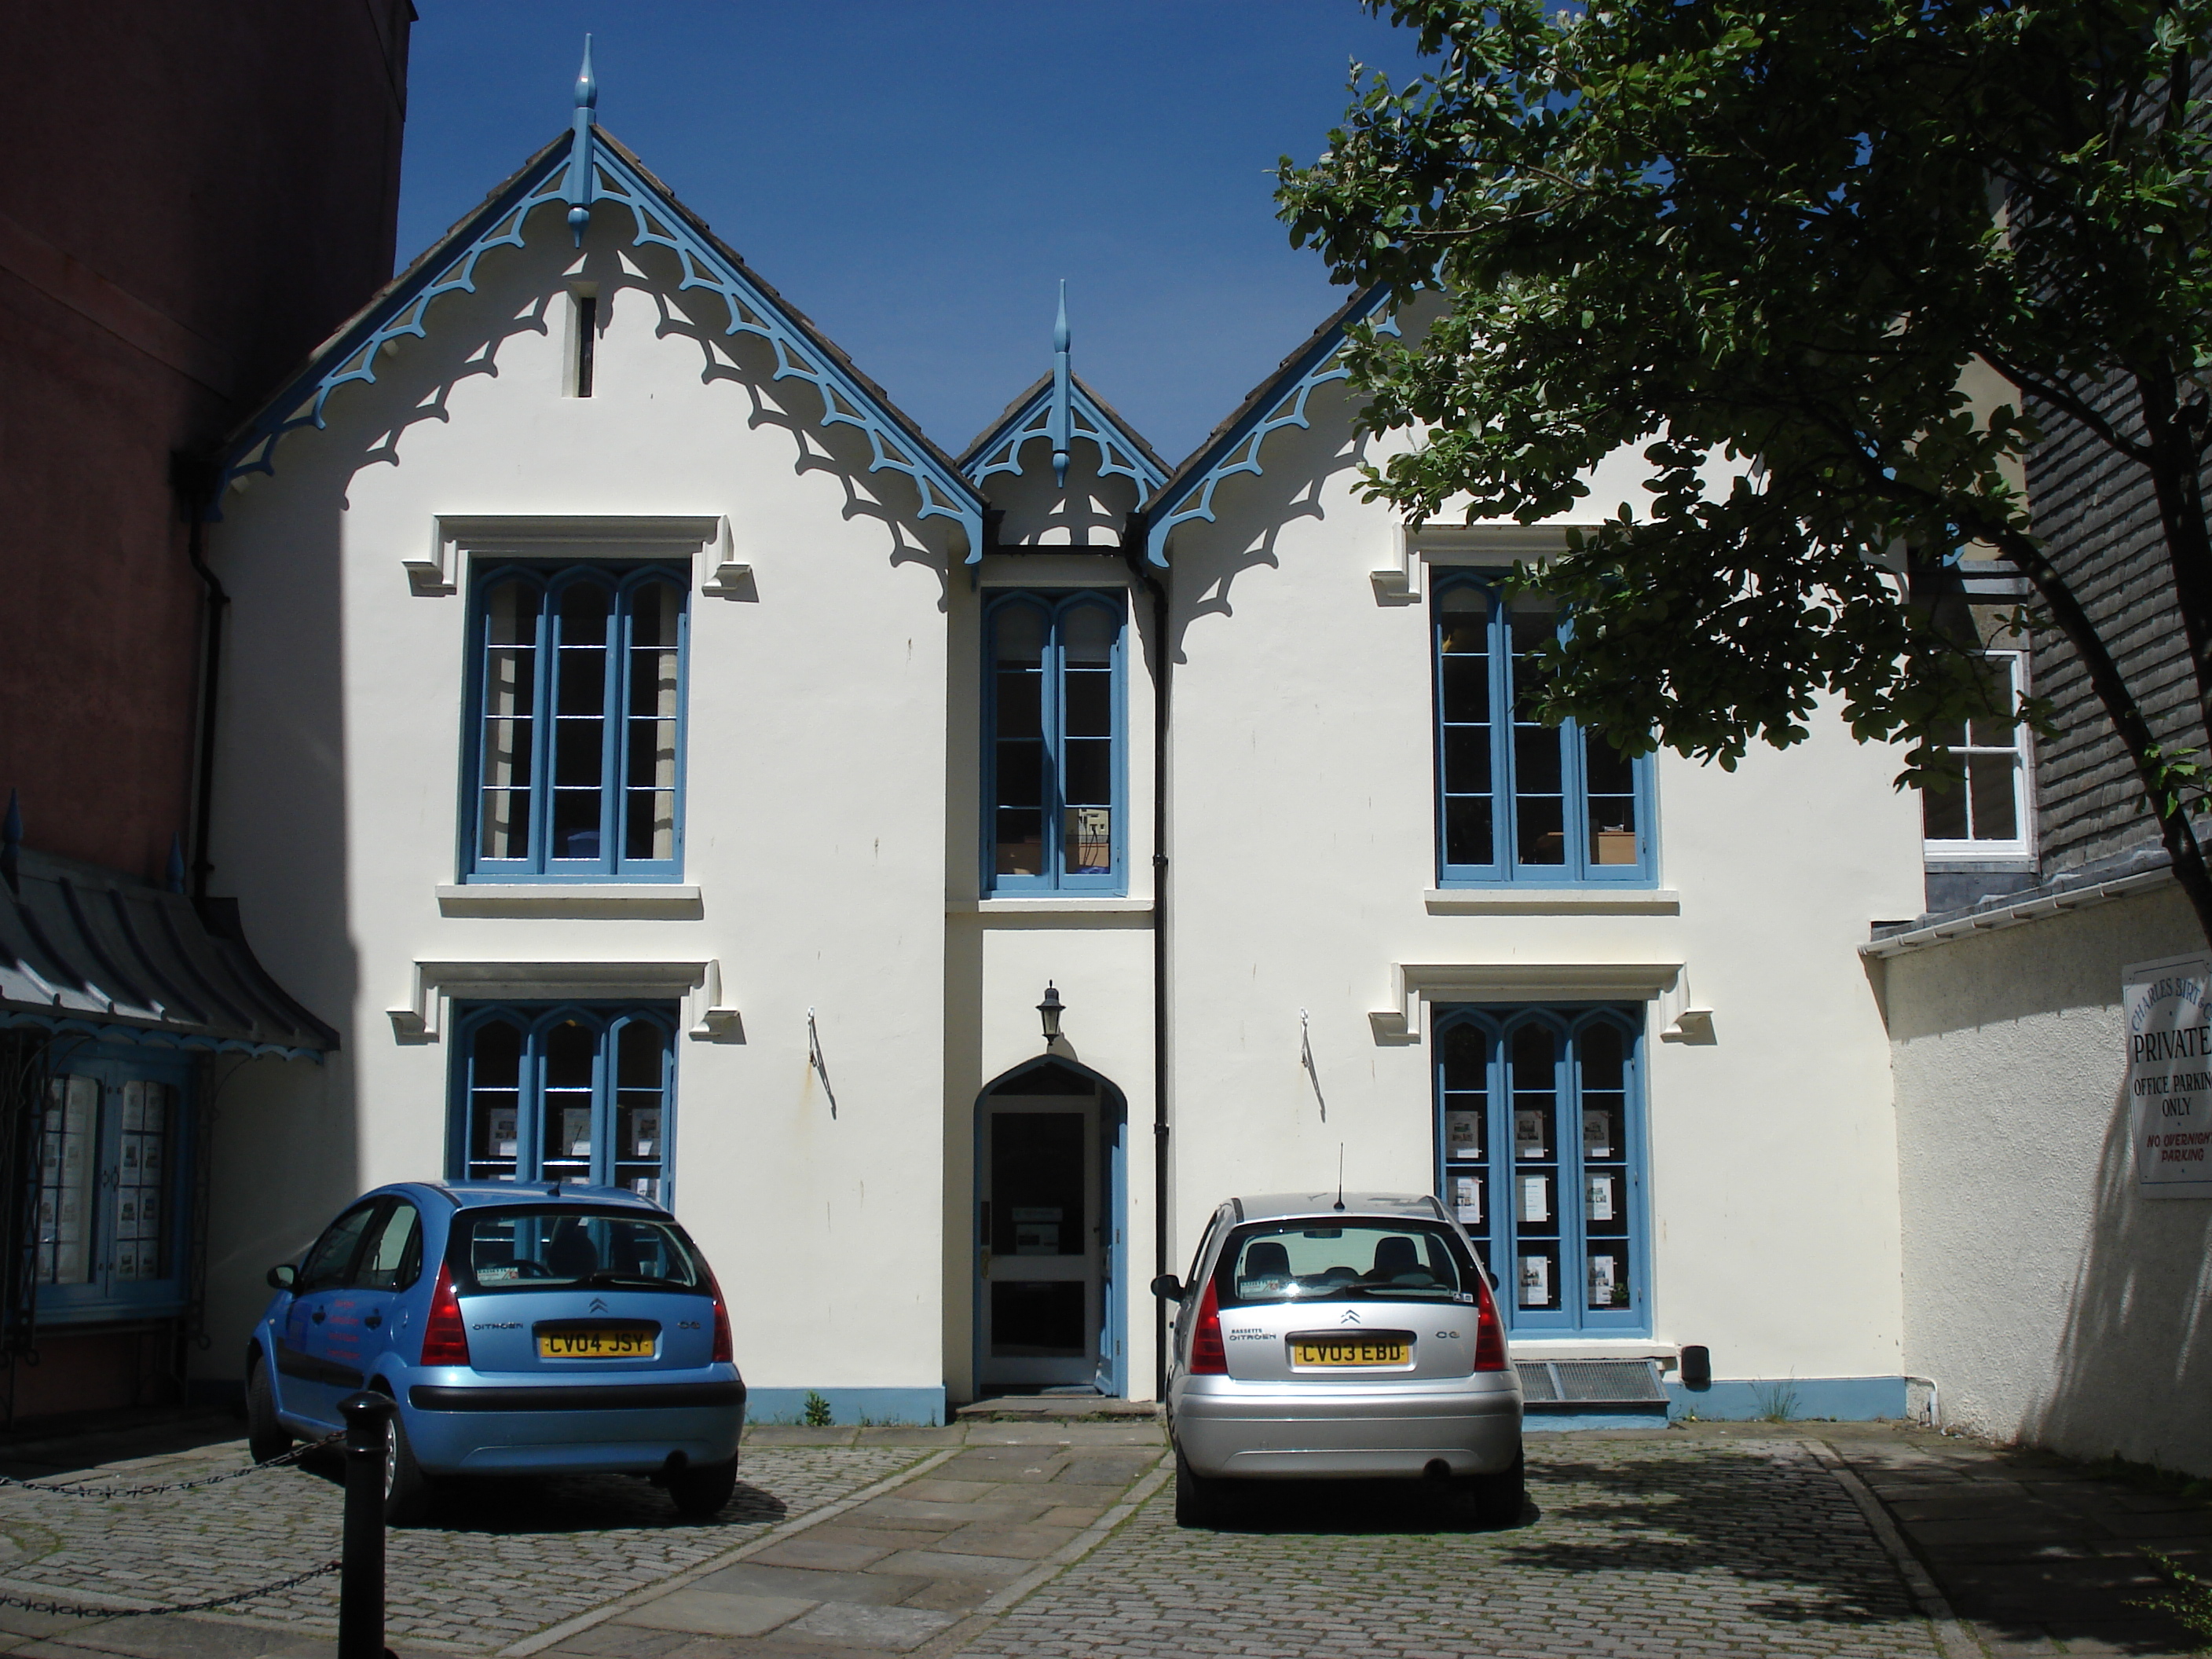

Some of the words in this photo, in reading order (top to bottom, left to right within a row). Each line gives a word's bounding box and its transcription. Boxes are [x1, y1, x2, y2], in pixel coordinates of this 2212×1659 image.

[2131, 978, 2173, 1031] CHARLES
[2175, 977, 2201, 1005] BIRT
[2198, 997, 2205, 1009] &
[2203, 1002, 2212, 1021] C
[2133, 1026, 2212, 1063] PRIVATE
[2134, 1076, 2169, 1096] OFFICE
[2173, 1071, 2212, 1093] PARKIN
[2162, 1097, 2192, 1117] ONLY
[2147, 1135, 2161, 1148] NO
[2162, 1148, 2205, 1163] PARKING
[550, 1333, 601, 1353] CV04
[609, 1331, 644, 1352] JSY
[1302, 1344, 1356, 1361] CV03
[1361, 1343, 1401, 1361] EBD
